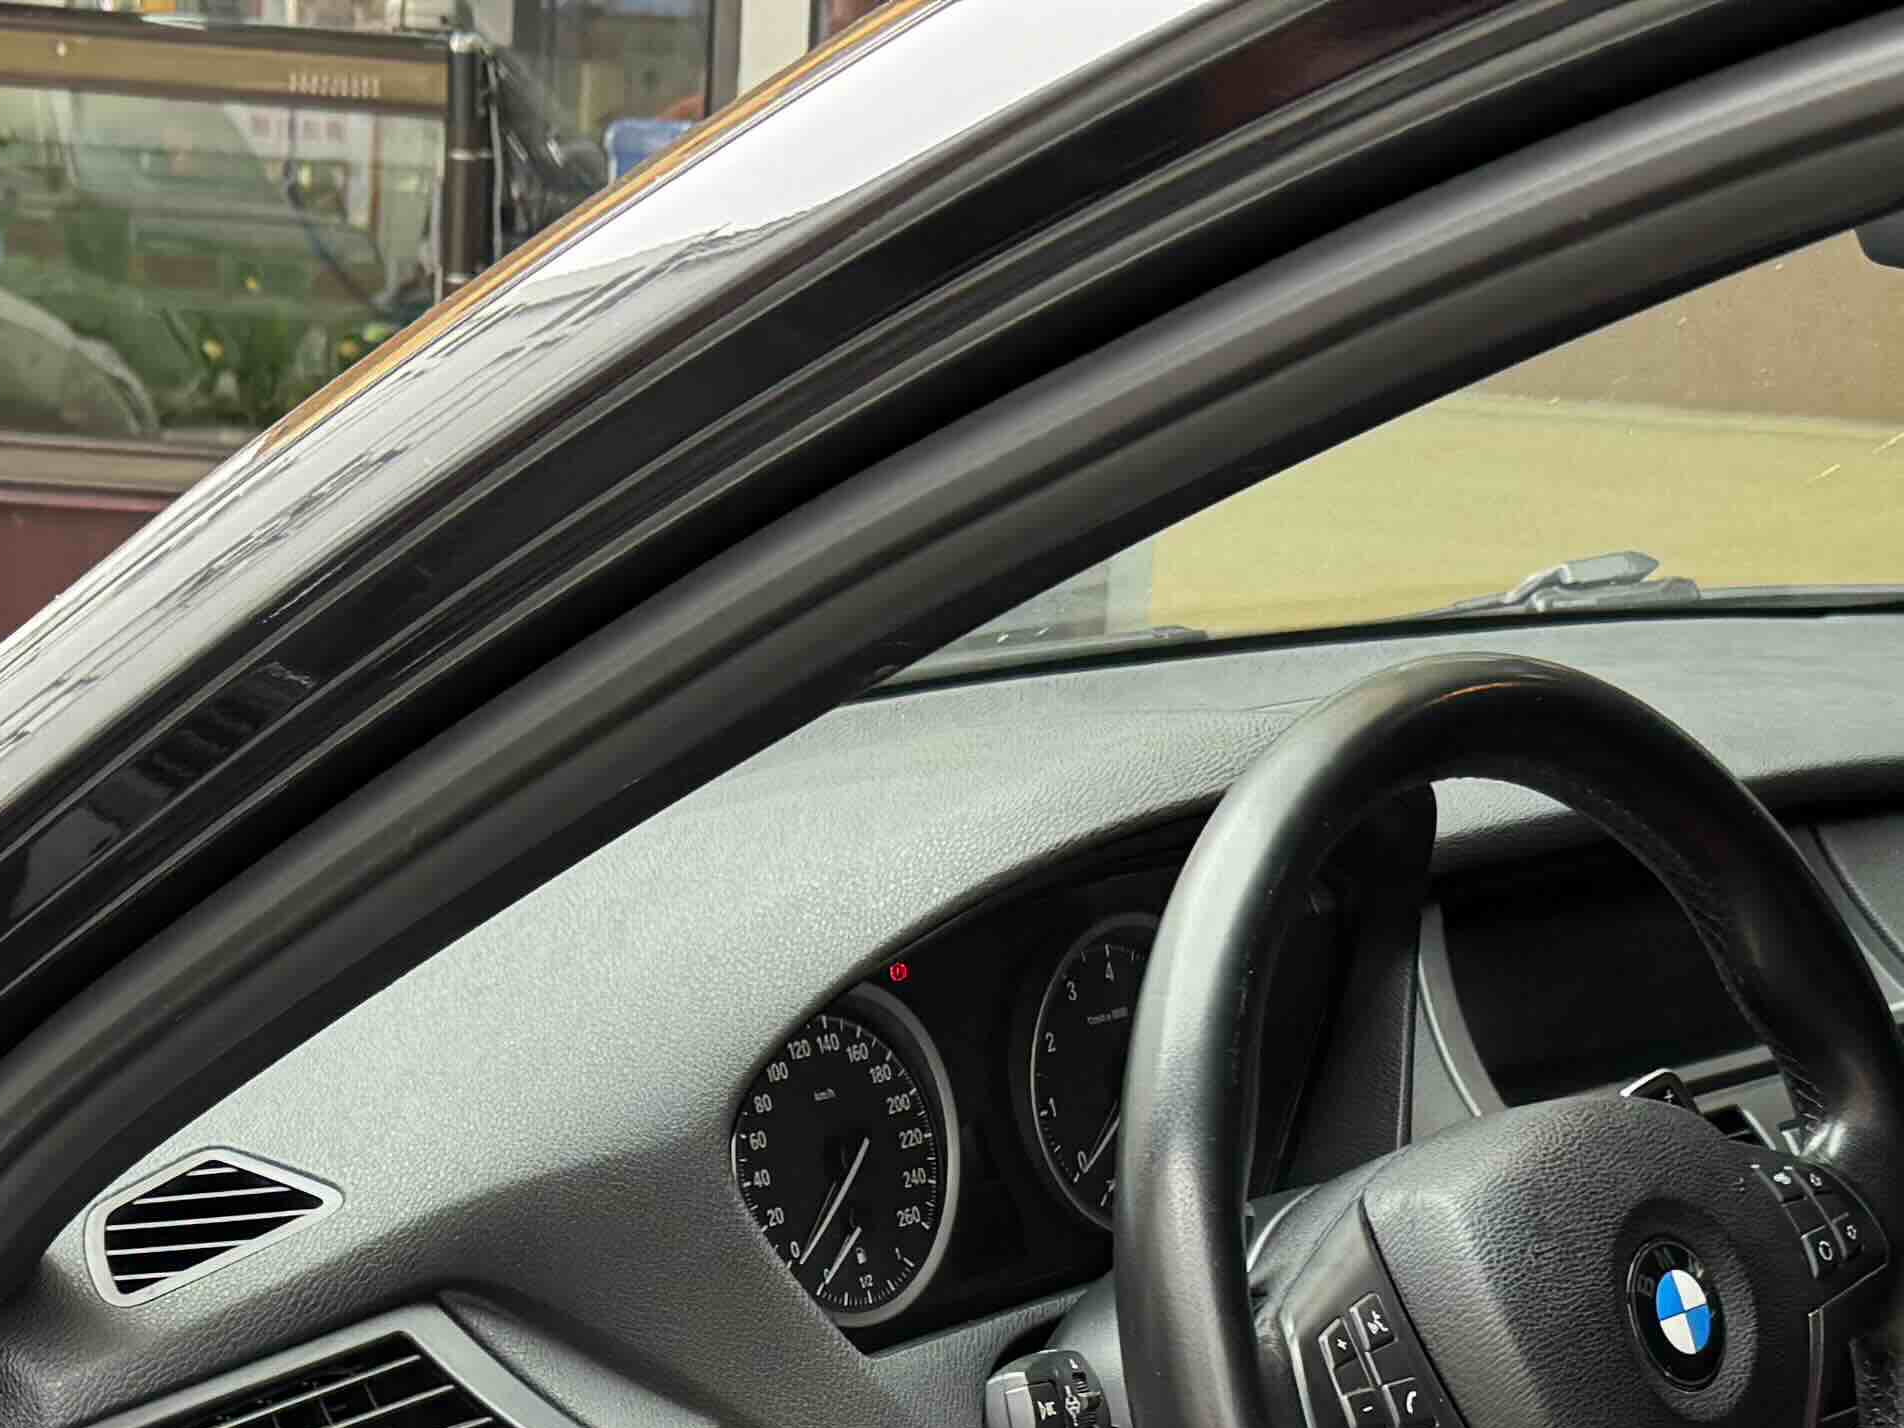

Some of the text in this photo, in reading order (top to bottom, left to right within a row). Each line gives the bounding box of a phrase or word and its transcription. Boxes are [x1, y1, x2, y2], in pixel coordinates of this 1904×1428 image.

[1105, 961, 1114, 982] 4
[1066, 980, 1077, 1001] 3
[787, 1039, 811, 1060] 120
[816, 1033, 840, 1053] 140
[846, 1042, 869, 1063] 160
[1046, 1032, 1056, 1053] 2
[766, 1061, 789, 1082] 100
[869, 1063, 892, 1084] 180
[753, 1093, 773, 1113] 80
[886, 1093, 912, 1115] 200
[1049, 1097, 1056, 1118] 1
[749, 1130, 767, 1150] 60
[898, 1127, 924, 1150] 220
[753, 1168, 771, 1188] 40
[902, 1167, 927, 1188] 240
[766, 1206, 785, 1227] 20
[896, 1205, 922, 1228] 260
[789, 1241, 801, 1259] 0
